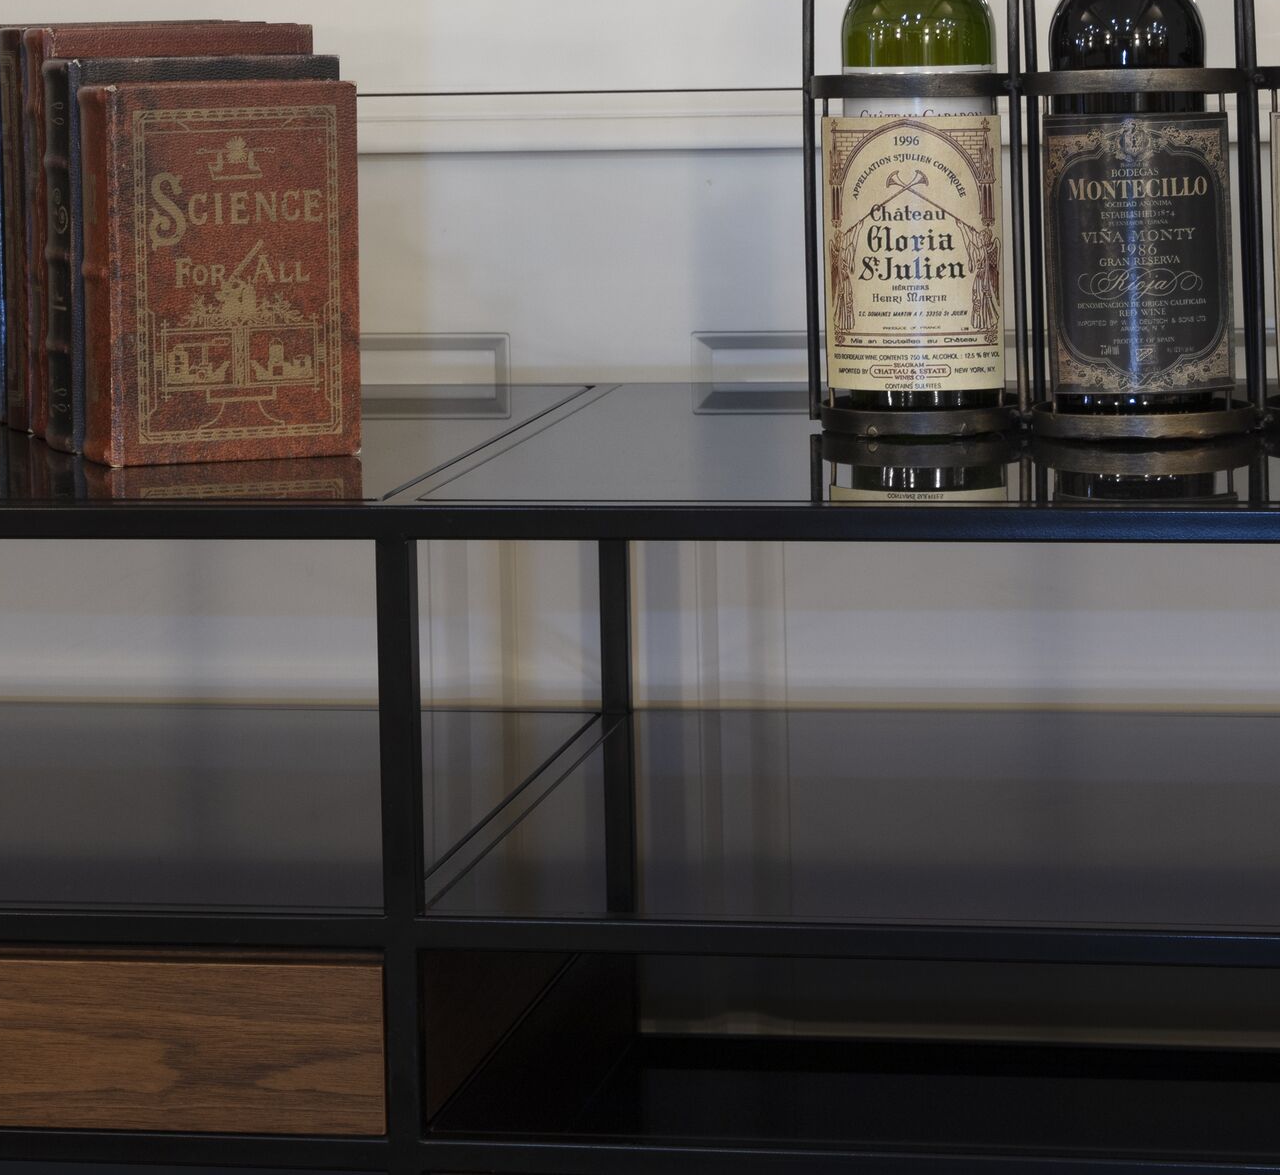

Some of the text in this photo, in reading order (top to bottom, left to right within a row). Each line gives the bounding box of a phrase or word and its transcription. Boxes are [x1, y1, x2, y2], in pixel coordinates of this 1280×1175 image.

[893, 135, 920, 147] 1996
[852, 155, 892, 200] APPELLATION
[1111, 168, 1159, 178] BODEGAS
[1068, 176, 1208, 201] MONTECILLO
[149, 172, 324, 250] SCIENCE
[870, 204, 946, 222] Château
[1100, 209, 1156, 219] ESTABLISHED
[867, 225, 955, 253] Gloria
[1081, 227, 1196, 244] VIÑA MONTY
[1121, 243, 1157, 256] 1986
[1099, 255, 1181, 267] GRAN RESERVA
[174, 254, 311, 289] FOR ALL
[1141, 299, 1169, 308] ORIGEN
[1119, 308, 1167, 317] RED WINE
[943, 336, 978, 344] Château
